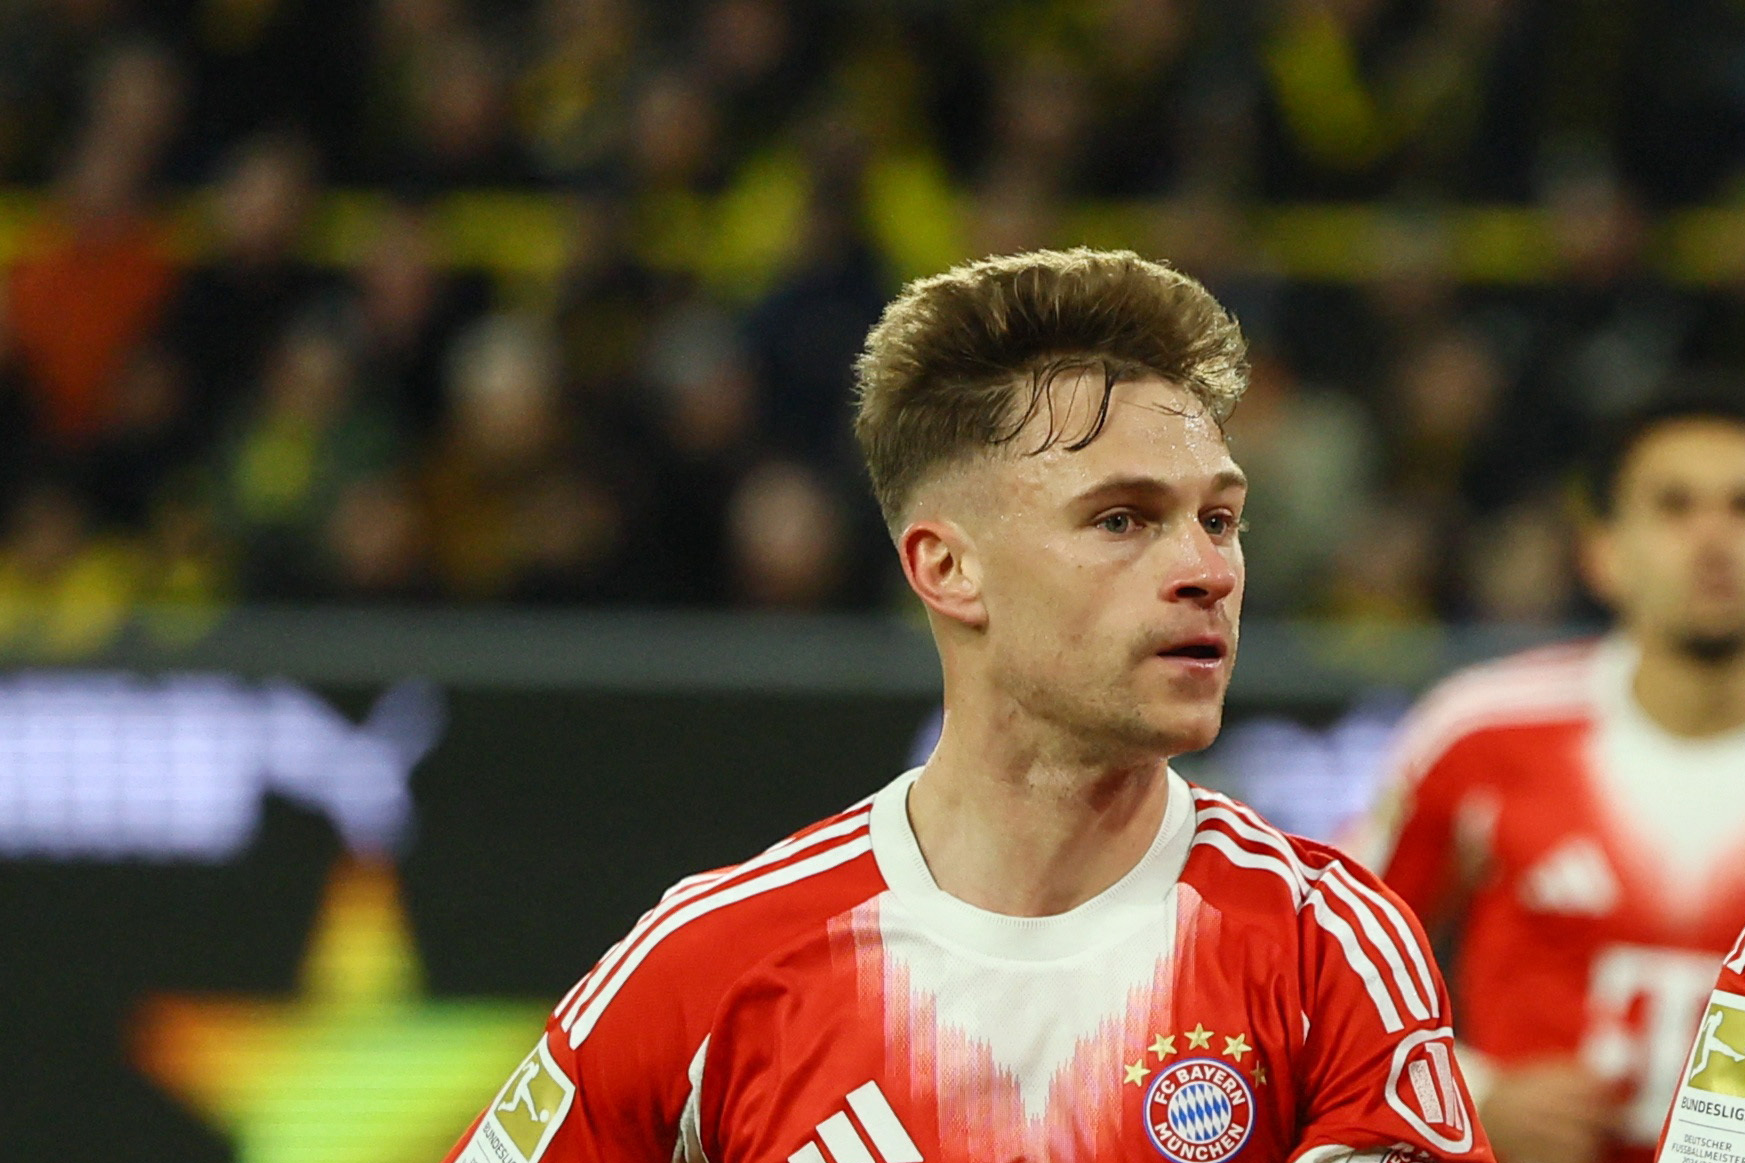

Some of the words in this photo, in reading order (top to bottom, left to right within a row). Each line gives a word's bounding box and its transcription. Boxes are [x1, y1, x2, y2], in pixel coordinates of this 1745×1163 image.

[1154, 1079, 1176, 1105] FC
[1176, 1063, 1247, 1106] BAYERN
[1154, 1120, 1246, 1161] MÜNCHEN
[1683, 1133, 1733, 1152] DEUTSCHER
